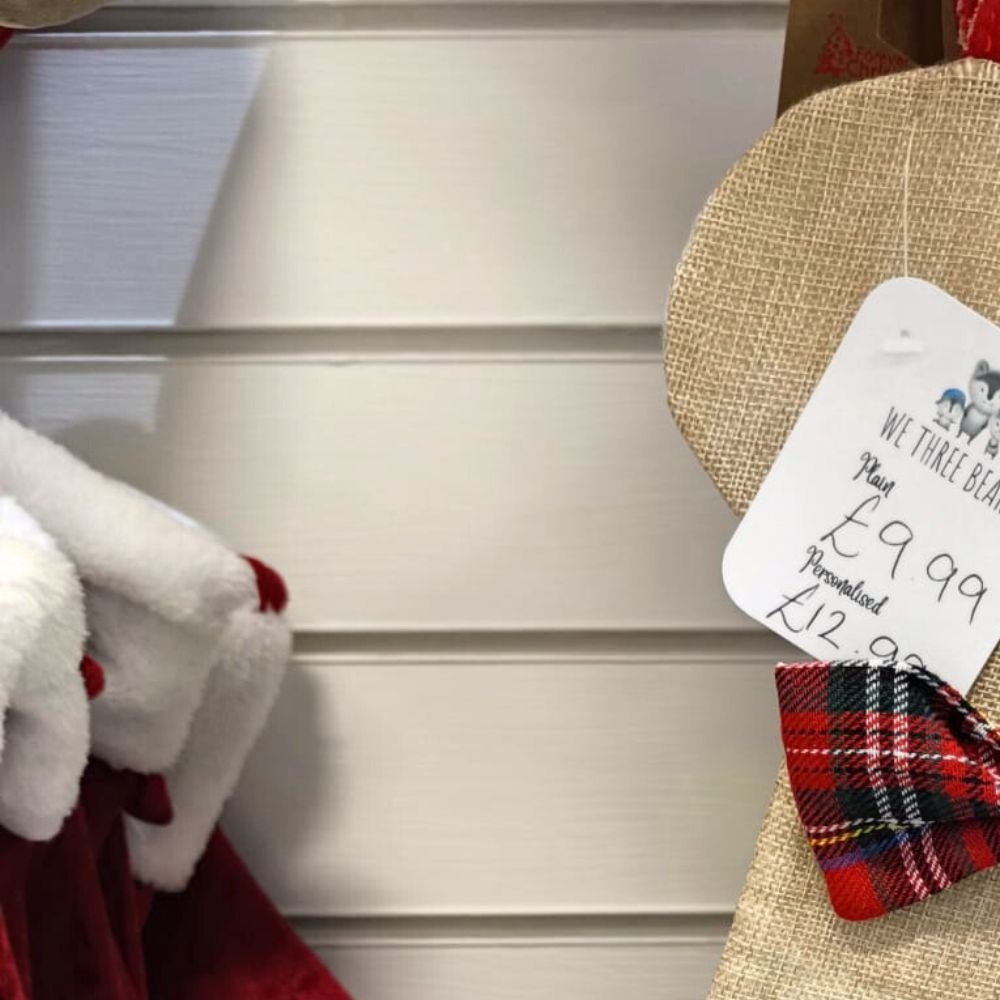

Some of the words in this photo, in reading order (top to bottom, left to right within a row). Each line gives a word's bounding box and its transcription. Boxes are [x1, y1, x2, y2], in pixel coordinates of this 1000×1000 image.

[853, 451, 896, 498] Plain
[880, 406, 914, 448] WE
[911, 425, 968, 484] THREE
[799, 545, 890, 616] Personalised
